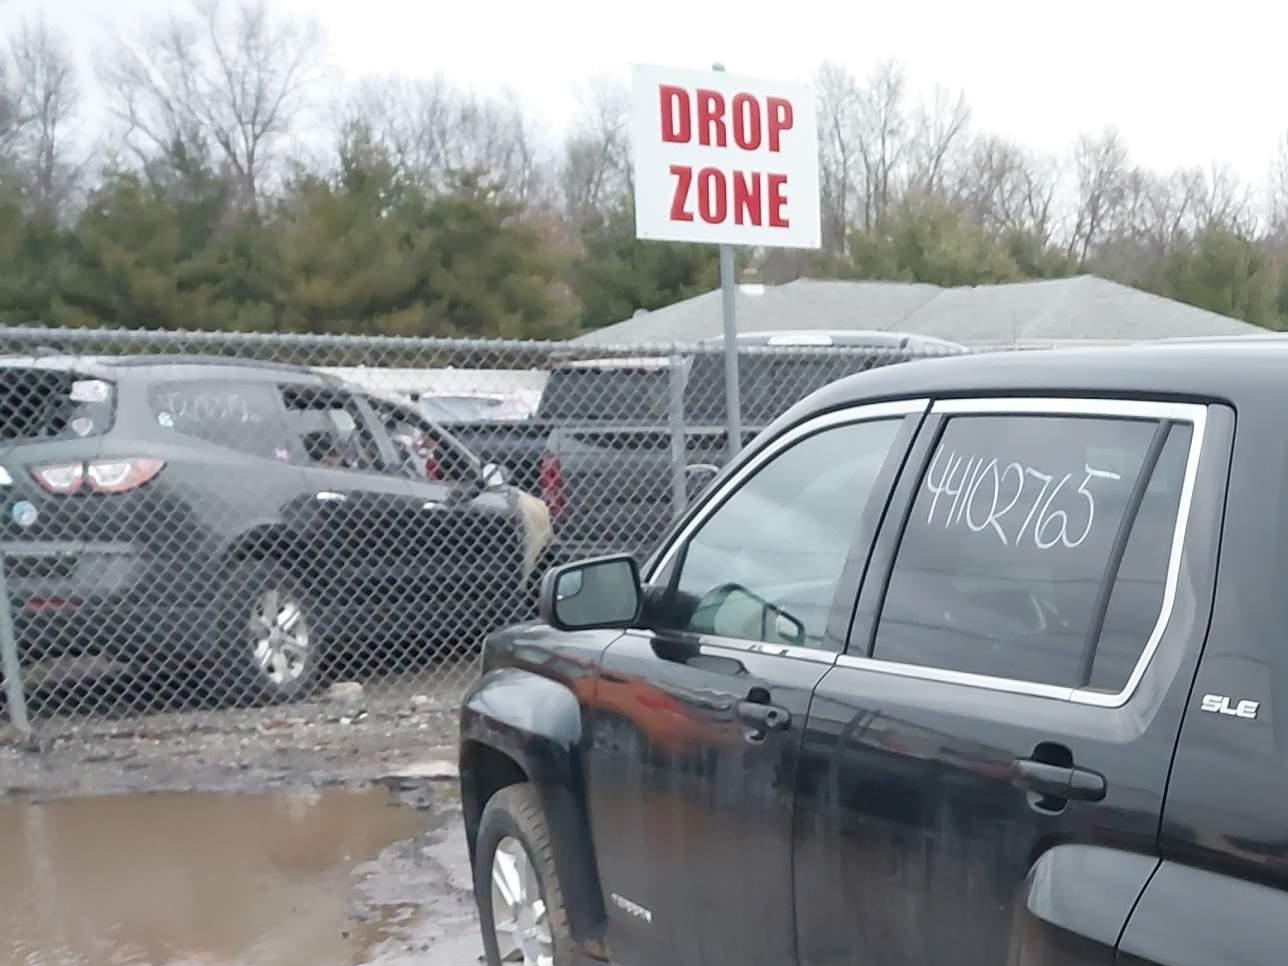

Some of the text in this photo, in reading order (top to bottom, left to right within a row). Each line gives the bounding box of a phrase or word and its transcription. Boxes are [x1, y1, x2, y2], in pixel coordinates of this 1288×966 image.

[659, 83, 794, 153] DROP
[670, 164, 790, 228] ZONE
[926, 443, 1121, 549] 44102765
[1200, 694, 1260, 719] SLE
